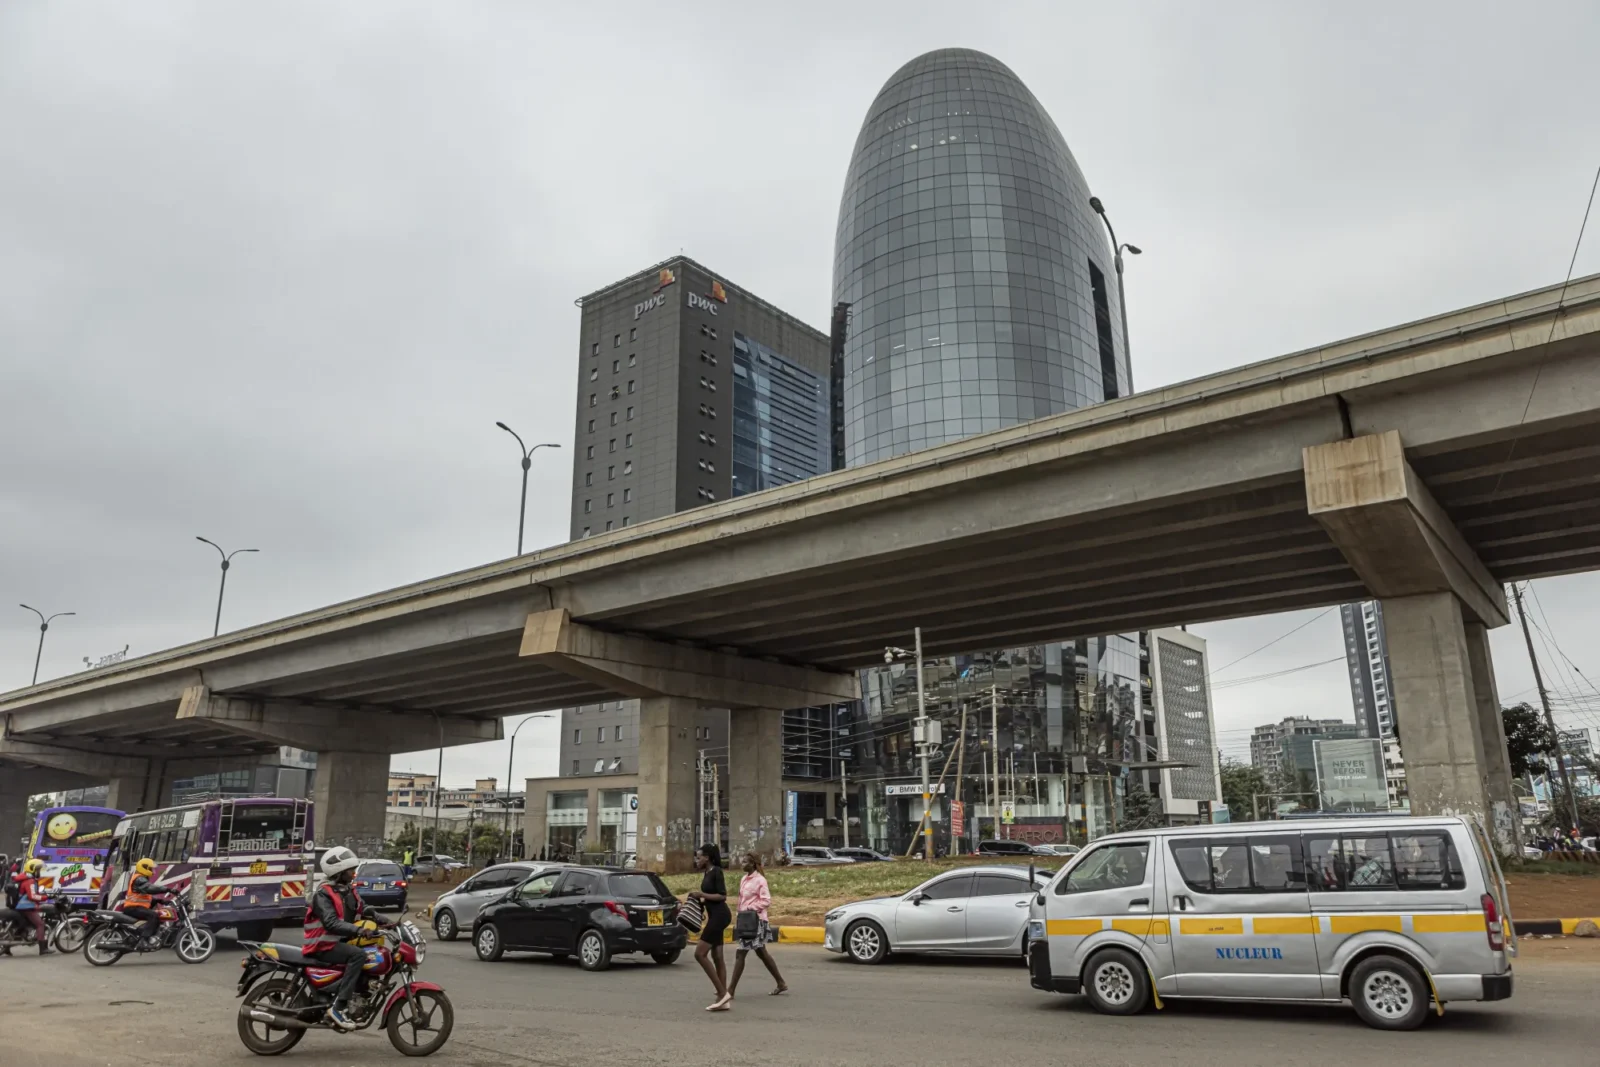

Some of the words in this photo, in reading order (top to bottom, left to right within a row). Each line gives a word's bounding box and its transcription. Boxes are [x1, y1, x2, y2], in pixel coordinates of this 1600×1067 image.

[634, 294, 665, 320] pwc
[688, 292, 718, 316] pwc
[229, 838, 279, 851] enabled
[1216, 947, 1283, 960] NUCLEUR
